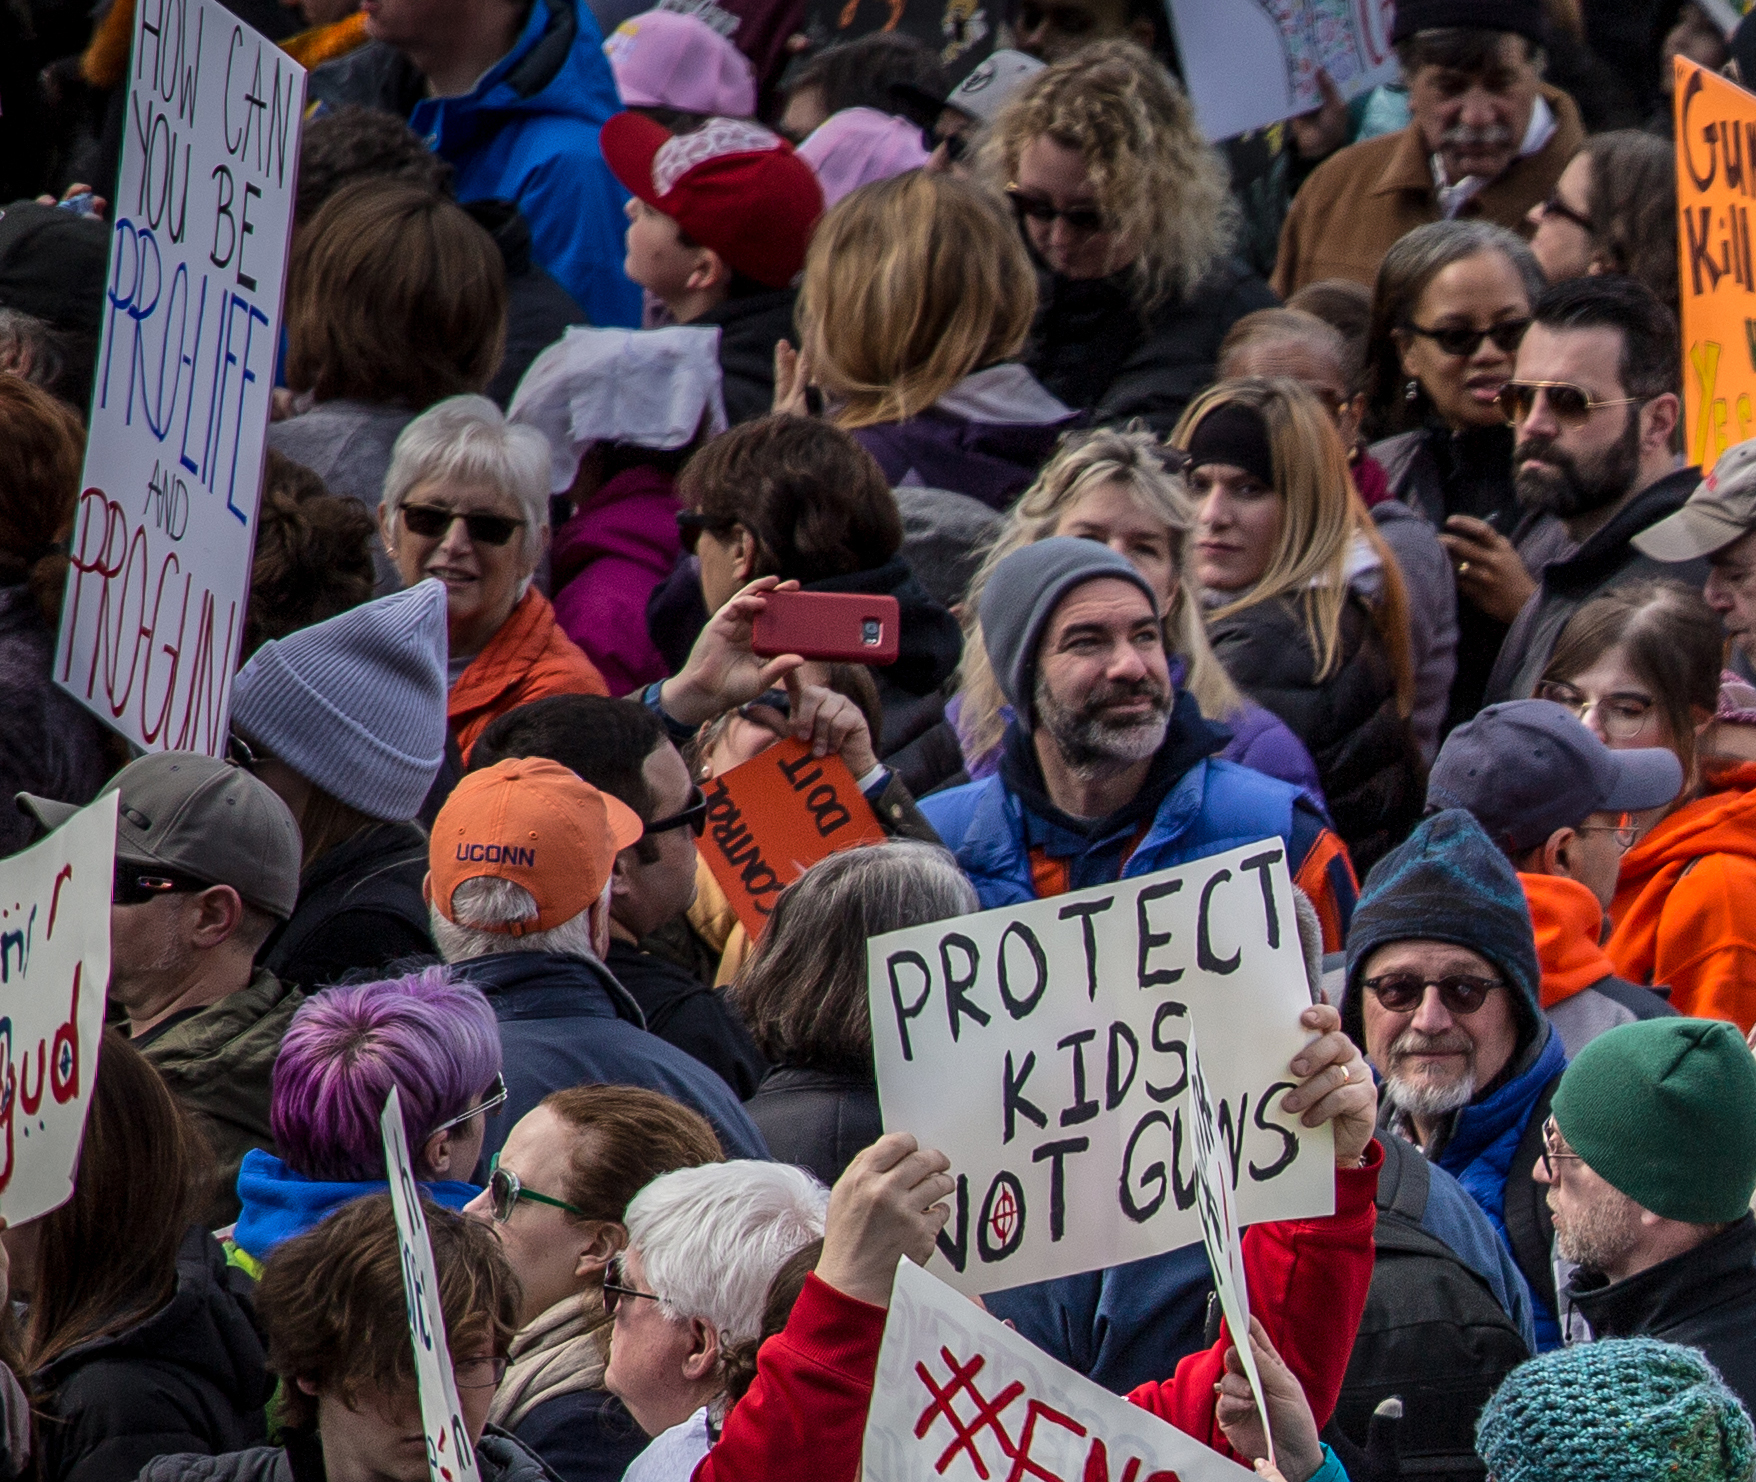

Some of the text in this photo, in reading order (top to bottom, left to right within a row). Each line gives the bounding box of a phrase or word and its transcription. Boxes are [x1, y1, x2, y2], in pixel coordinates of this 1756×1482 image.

[138, 0, 293, 189] HOW CAN
[134, 89, 262, 293] YOU BE
[143, 459, 189, 541] AND
[455, 843, 535, 867] UCONN
[886, 849, 1283, 1061] PROTECT
[1003, 1001, 1189, 1145] KIDS
[1119, 1082, 1299, 1223] GUNS
